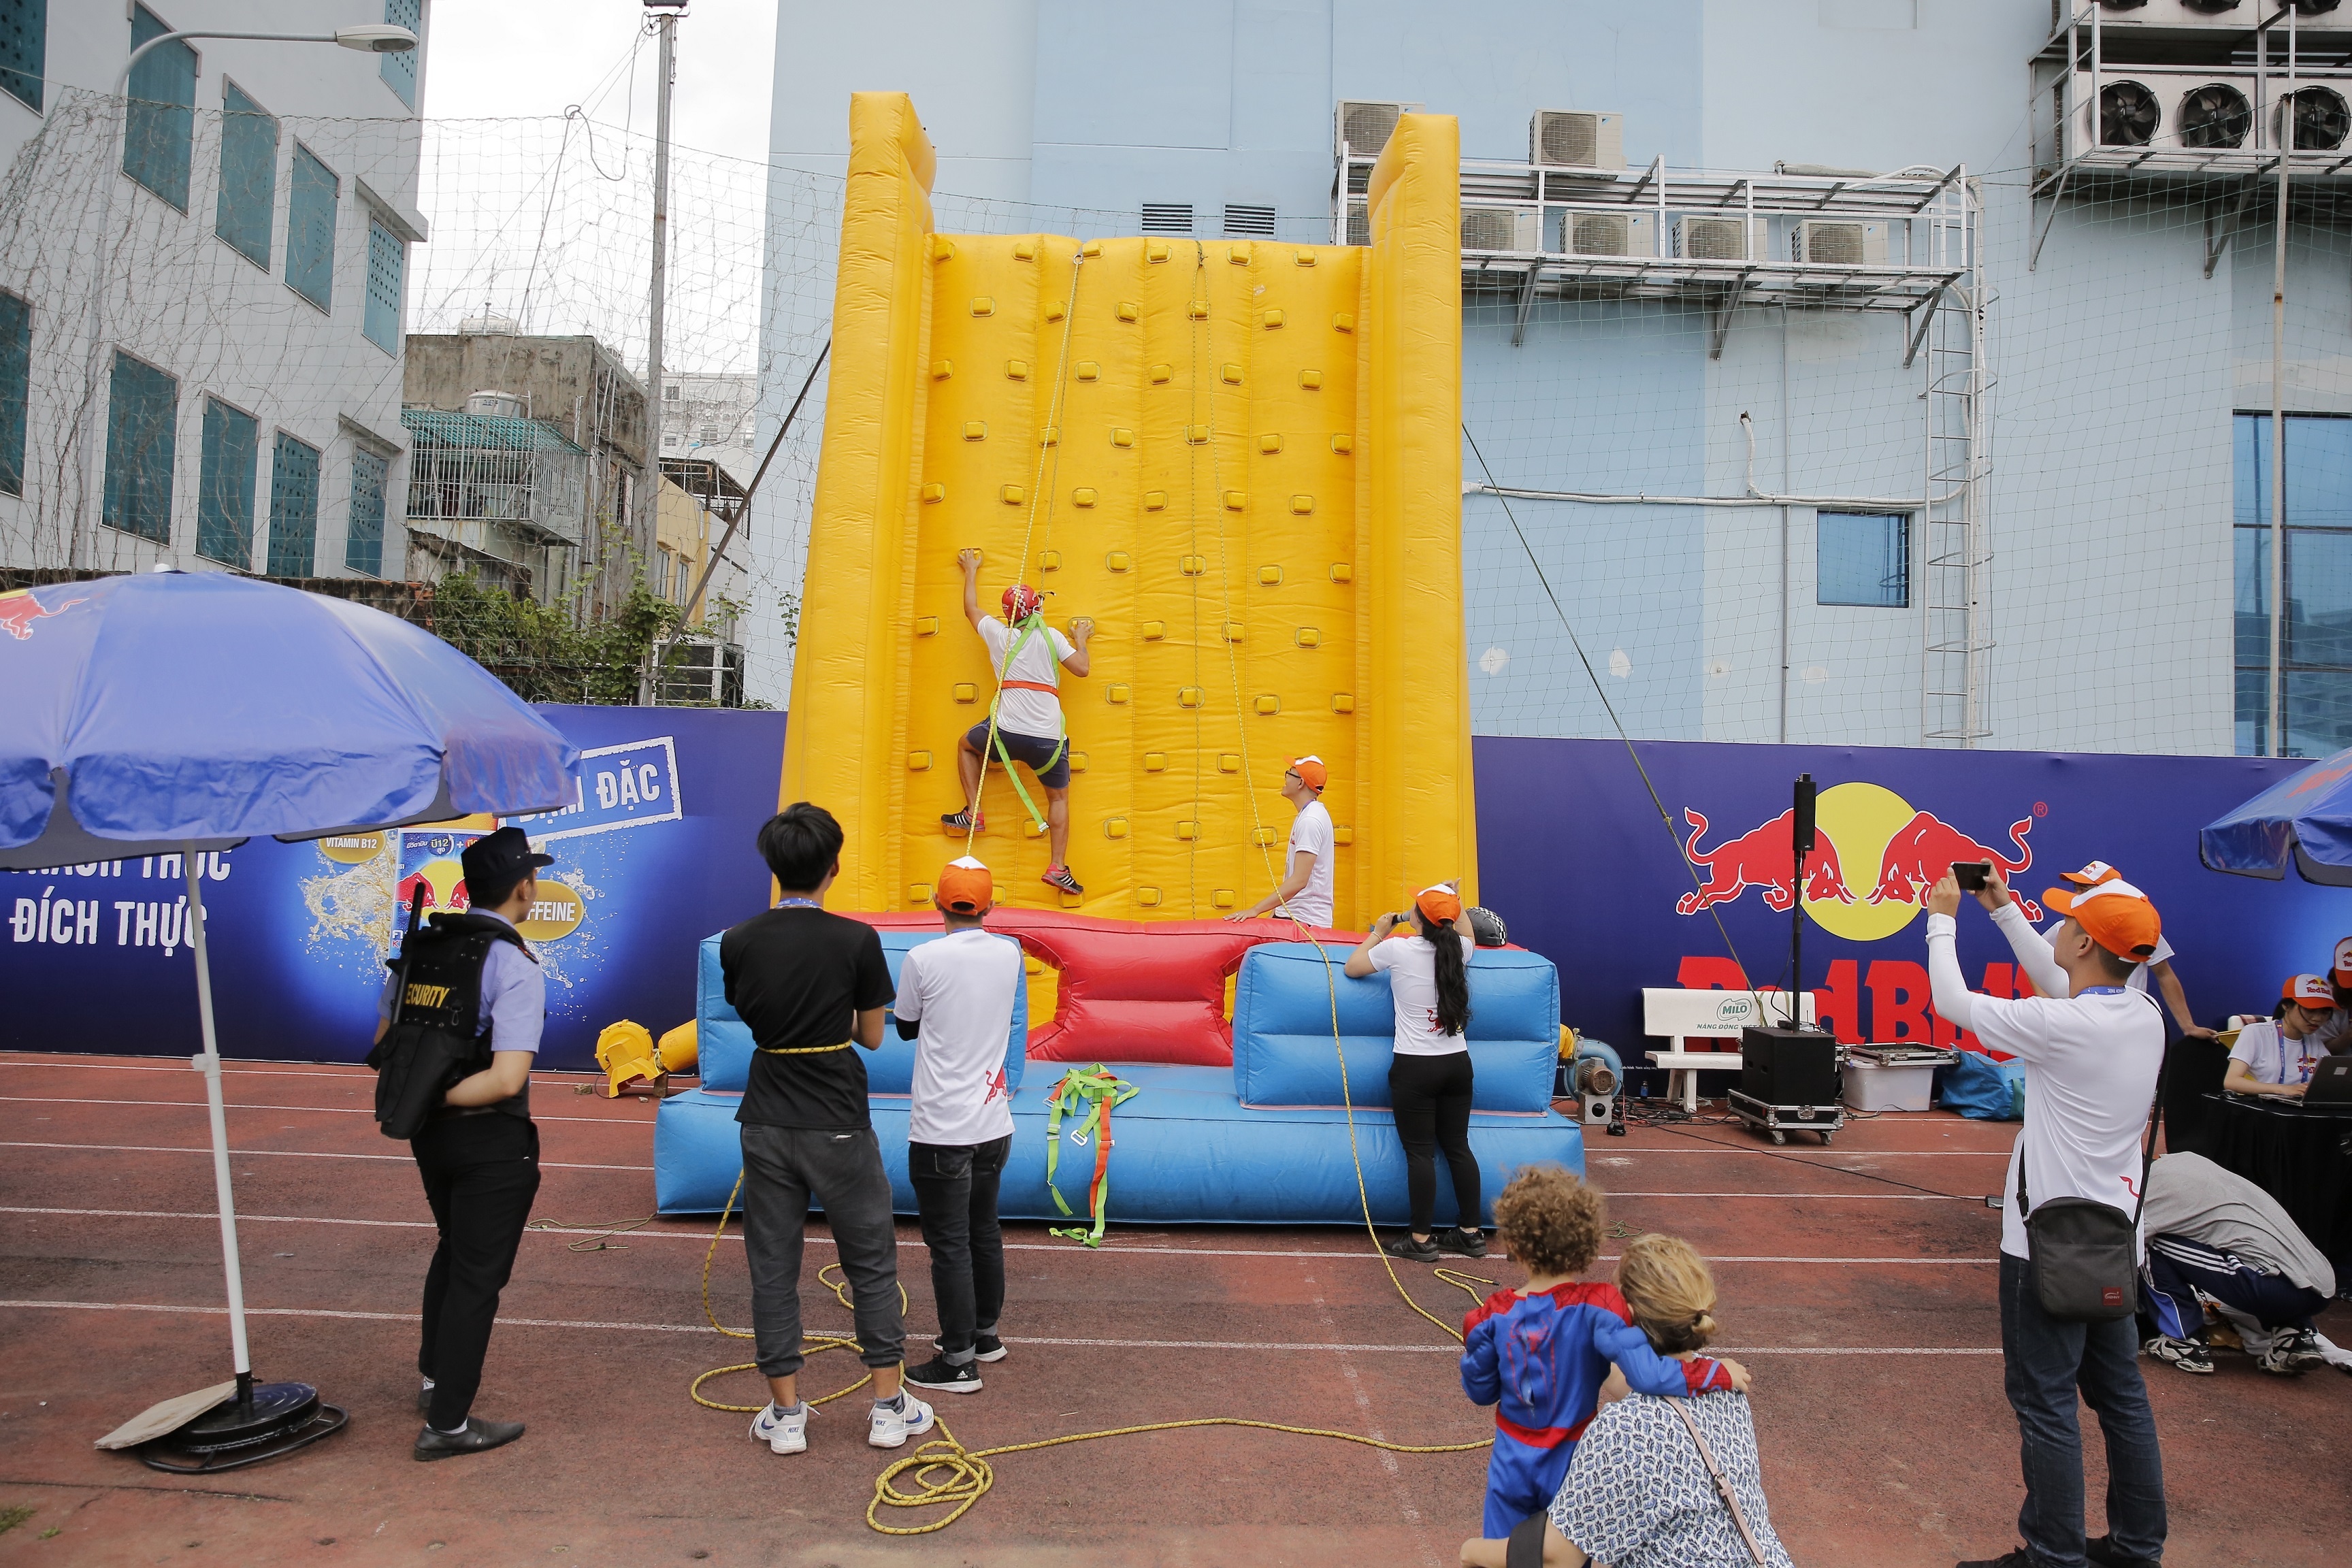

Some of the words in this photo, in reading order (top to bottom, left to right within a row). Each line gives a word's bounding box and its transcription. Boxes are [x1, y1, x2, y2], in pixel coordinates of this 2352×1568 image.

[596, 759, 661, 811] ĐẶC
[326, 838, 360, 848] VITAMIN
[361, 838, 378, 849] B12
[9, 885, 99, 945] ĐÍCH
[406, 983, 450, 1008] ECURITY
[1722, 1004, 1748, 1014] MILO
